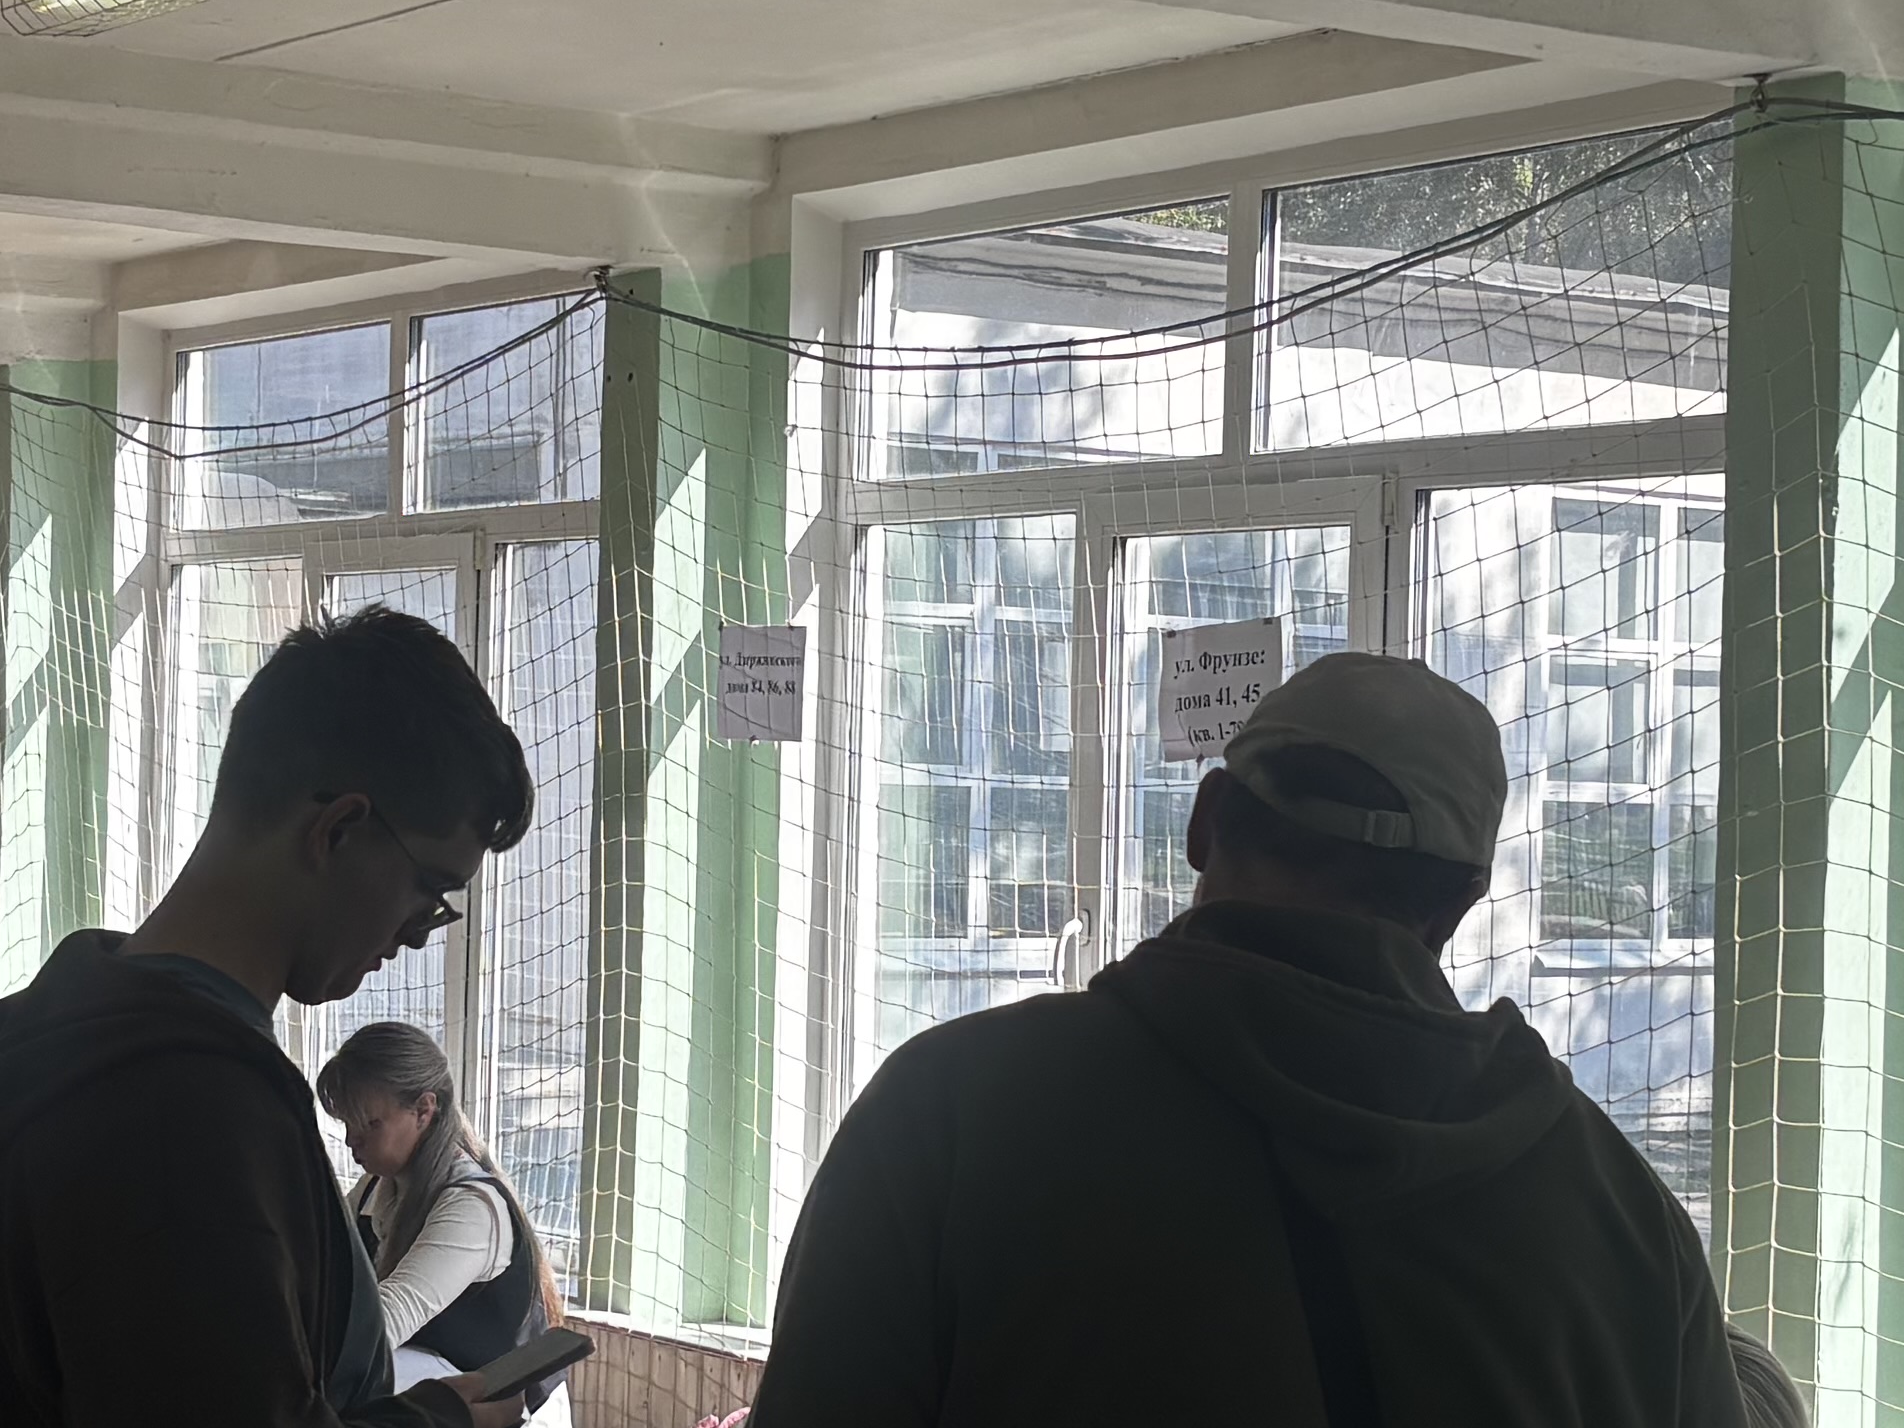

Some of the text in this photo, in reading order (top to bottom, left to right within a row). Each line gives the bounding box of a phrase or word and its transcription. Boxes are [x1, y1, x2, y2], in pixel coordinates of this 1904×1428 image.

[1173, 649, 1265, 680] ул. Фрунзе:
[1174, 693, 1211, 713] дома
[1215, 686, 1237, 708] 41,
[1187, 725, 1215, 748] (кв.
